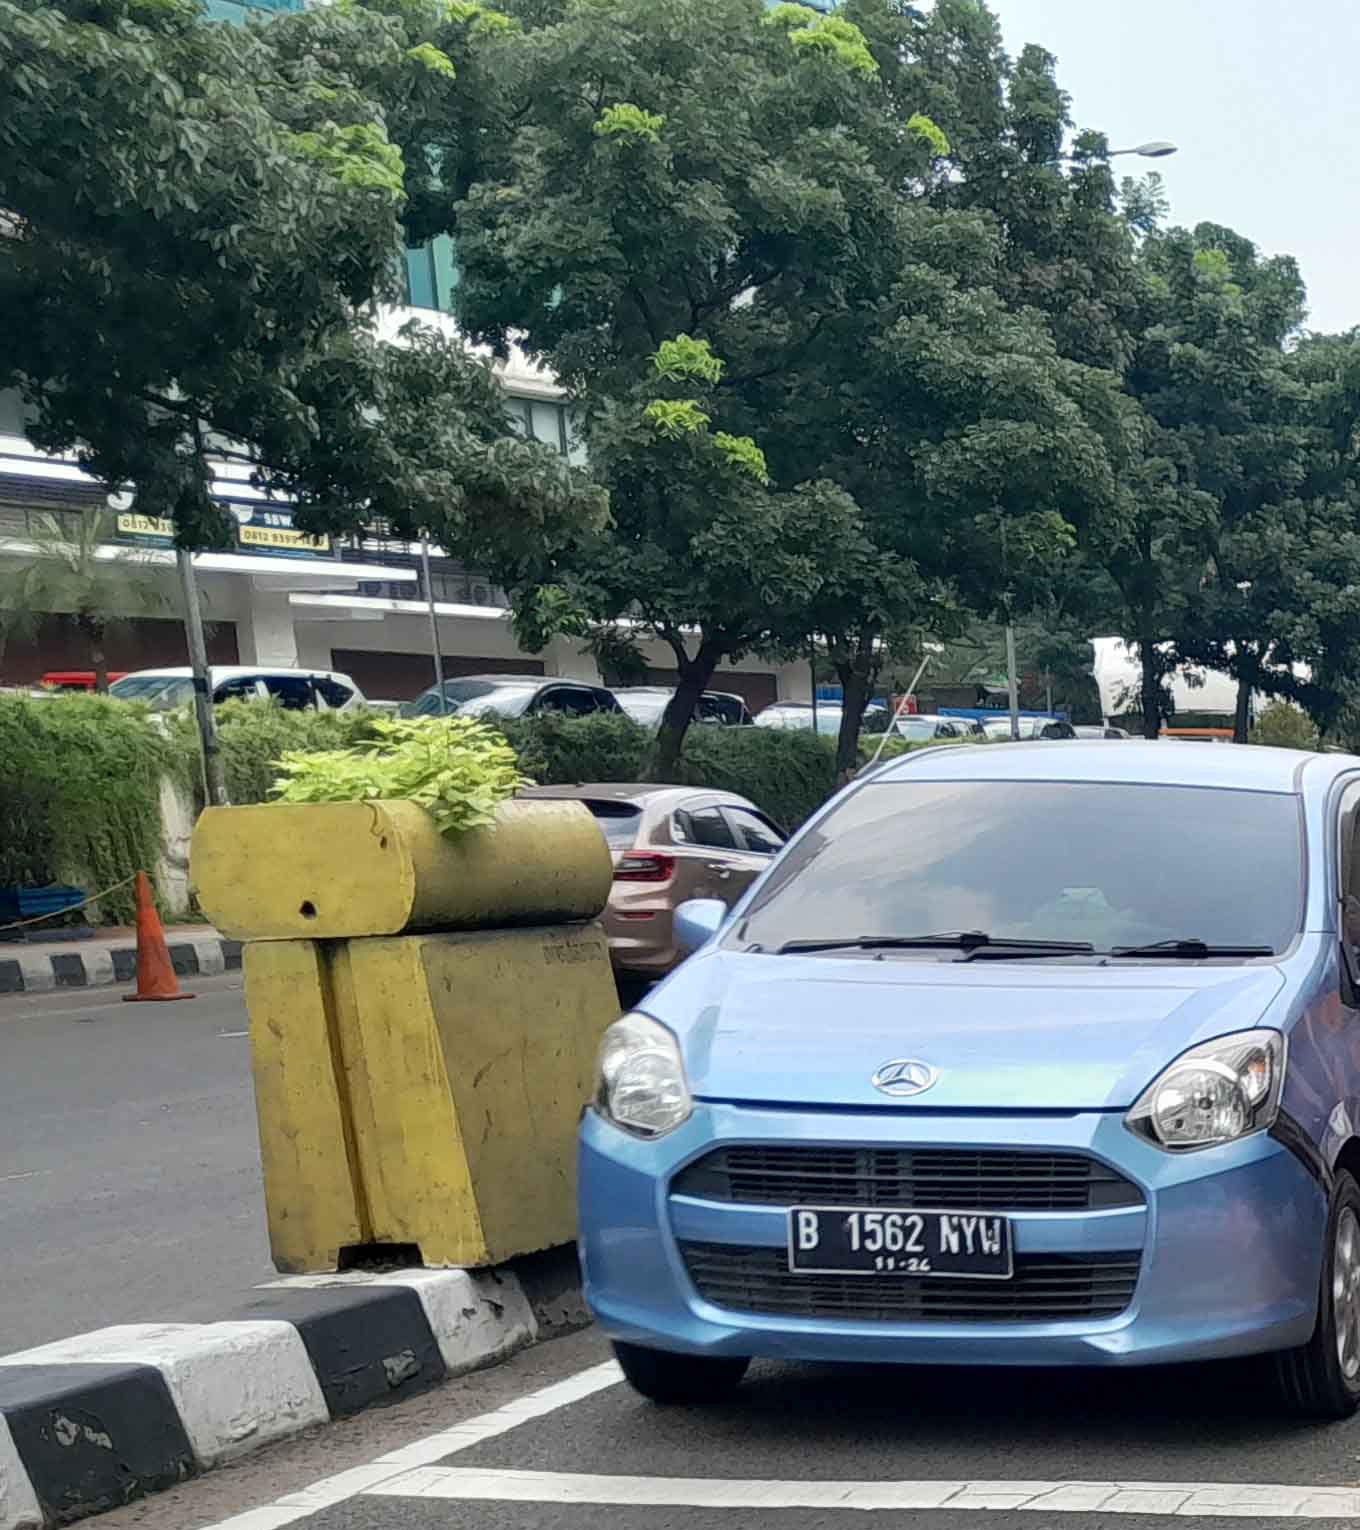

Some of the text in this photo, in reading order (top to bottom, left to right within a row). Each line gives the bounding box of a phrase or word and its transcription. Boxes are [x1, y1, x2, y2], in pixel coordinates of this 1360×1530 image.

[798, 1211, 1001, 1255] B 1562 NYW
